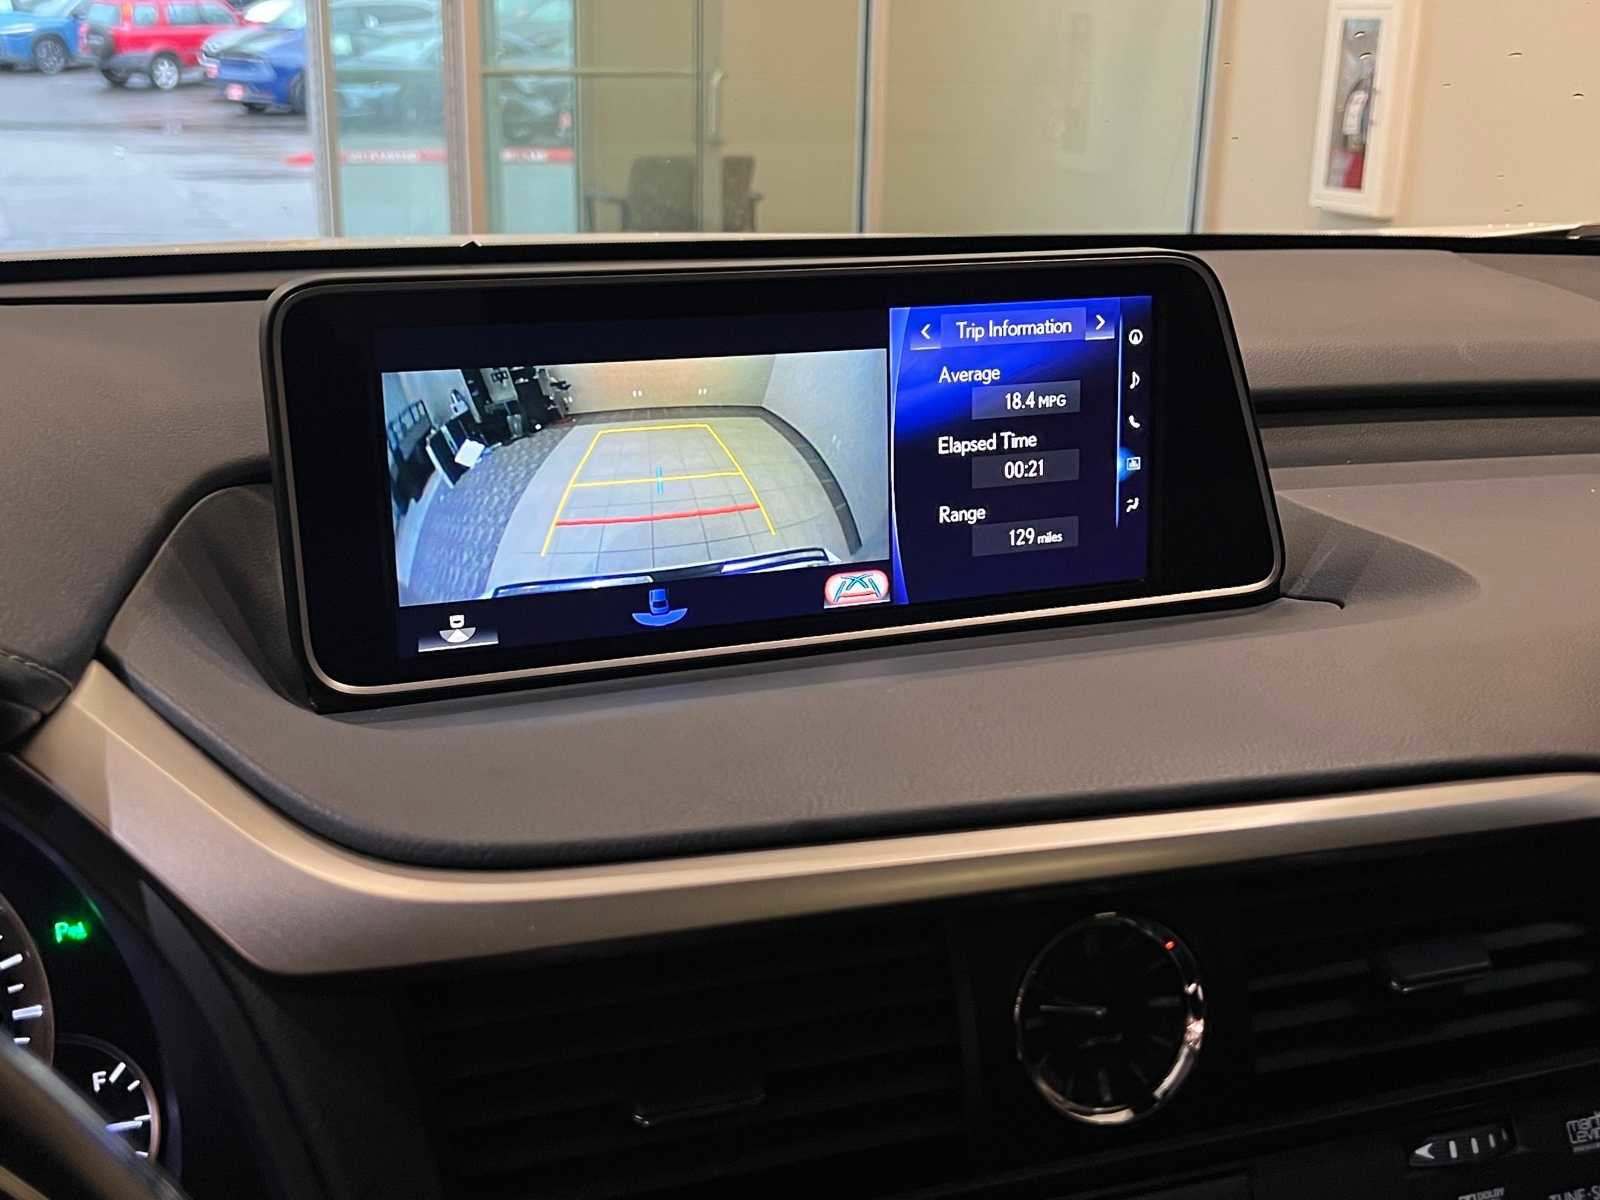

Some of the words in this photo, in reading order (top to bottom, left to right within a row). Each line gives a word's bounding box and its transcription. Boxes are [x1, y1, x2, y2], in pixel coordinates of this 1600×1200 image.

[956, 321, 985, 340] Trip
[988, 319, 1073, 338] Information
[938, 366, 1001, 384] Average
[1005, 391, 1036, 410] 18.4
[1038, 394, 1067, 408] MPG
[938, 433, 997, 456] Elapsed
[1000, 431, 1038, 450] Time
[1004, 459, 1044, 479] 00:21
[939, 506, 986, 524] Range
[1009, 528, 1035, 546] 129
[1037, 531, 1063, 545] miles
[92, 1071, 107, 1093] F
